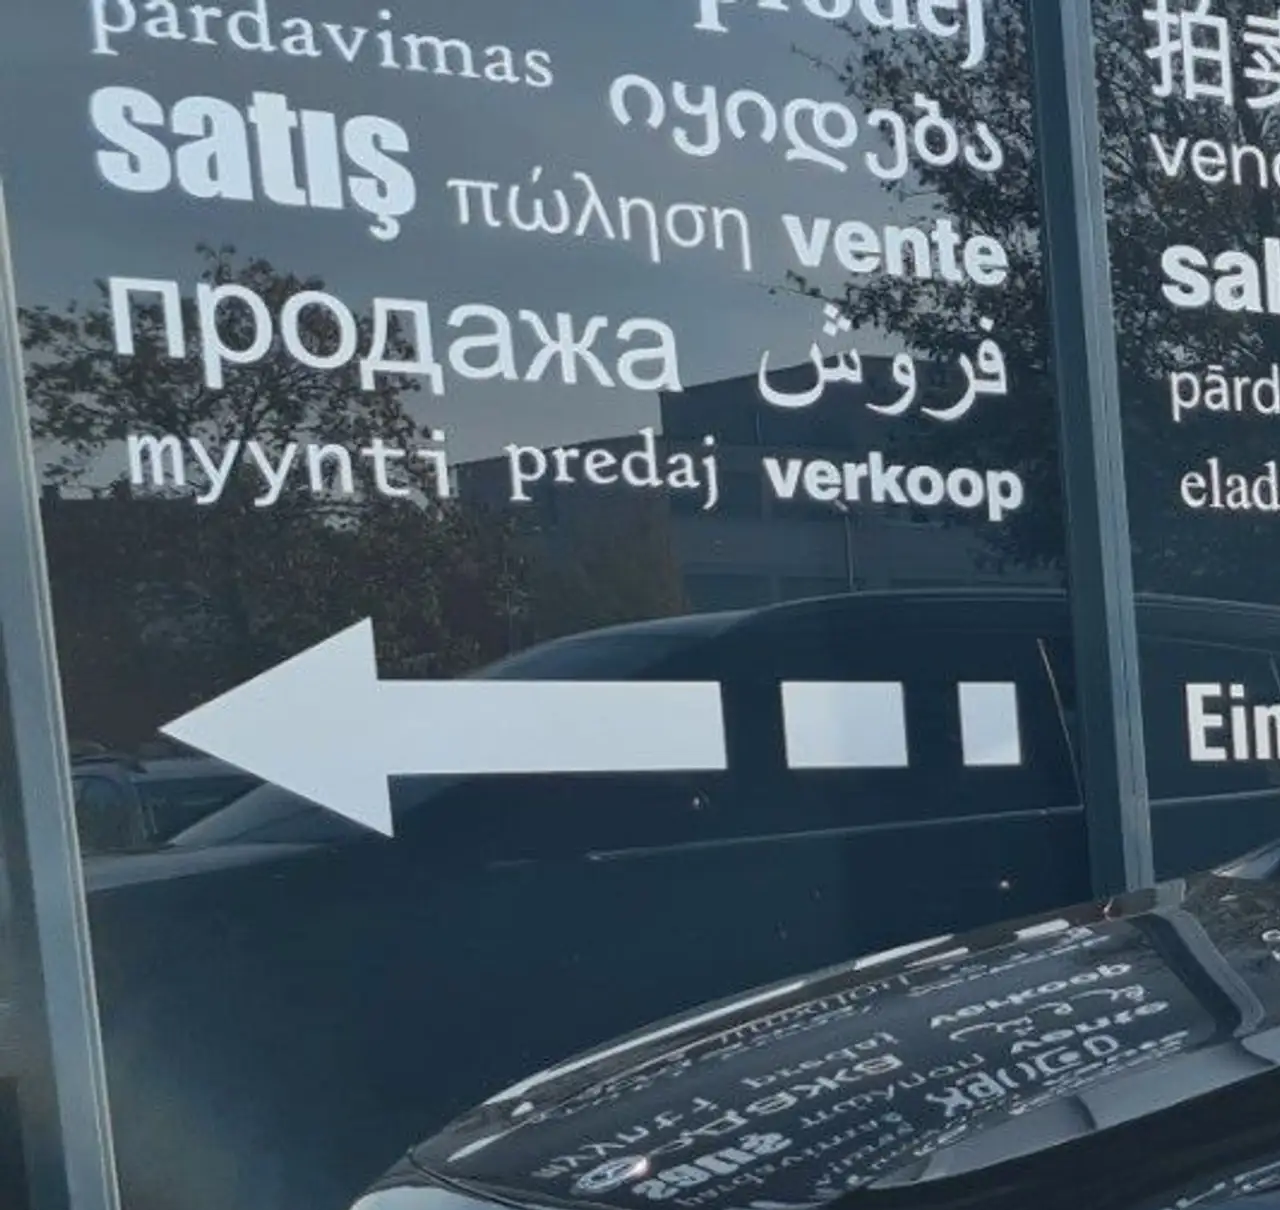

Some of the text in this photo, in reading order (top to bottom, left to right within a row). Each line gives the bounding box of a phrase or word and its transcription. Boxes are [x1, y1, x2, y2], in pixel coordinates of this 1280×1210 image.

[90, 0, 553, 88] pardavimas
[88, 86, 416, 241] satış
[446, 166, 752, 272] πώληση
[781, 213, 1009, 287] vente
[109, 276, 683, 396] продажа
[758, 302, 1008, 422] فروش
[127, 429, 456, 507] myynti
[504, 427, 718, 511] predaj
[762, 451, 1025, 522] verkoop
